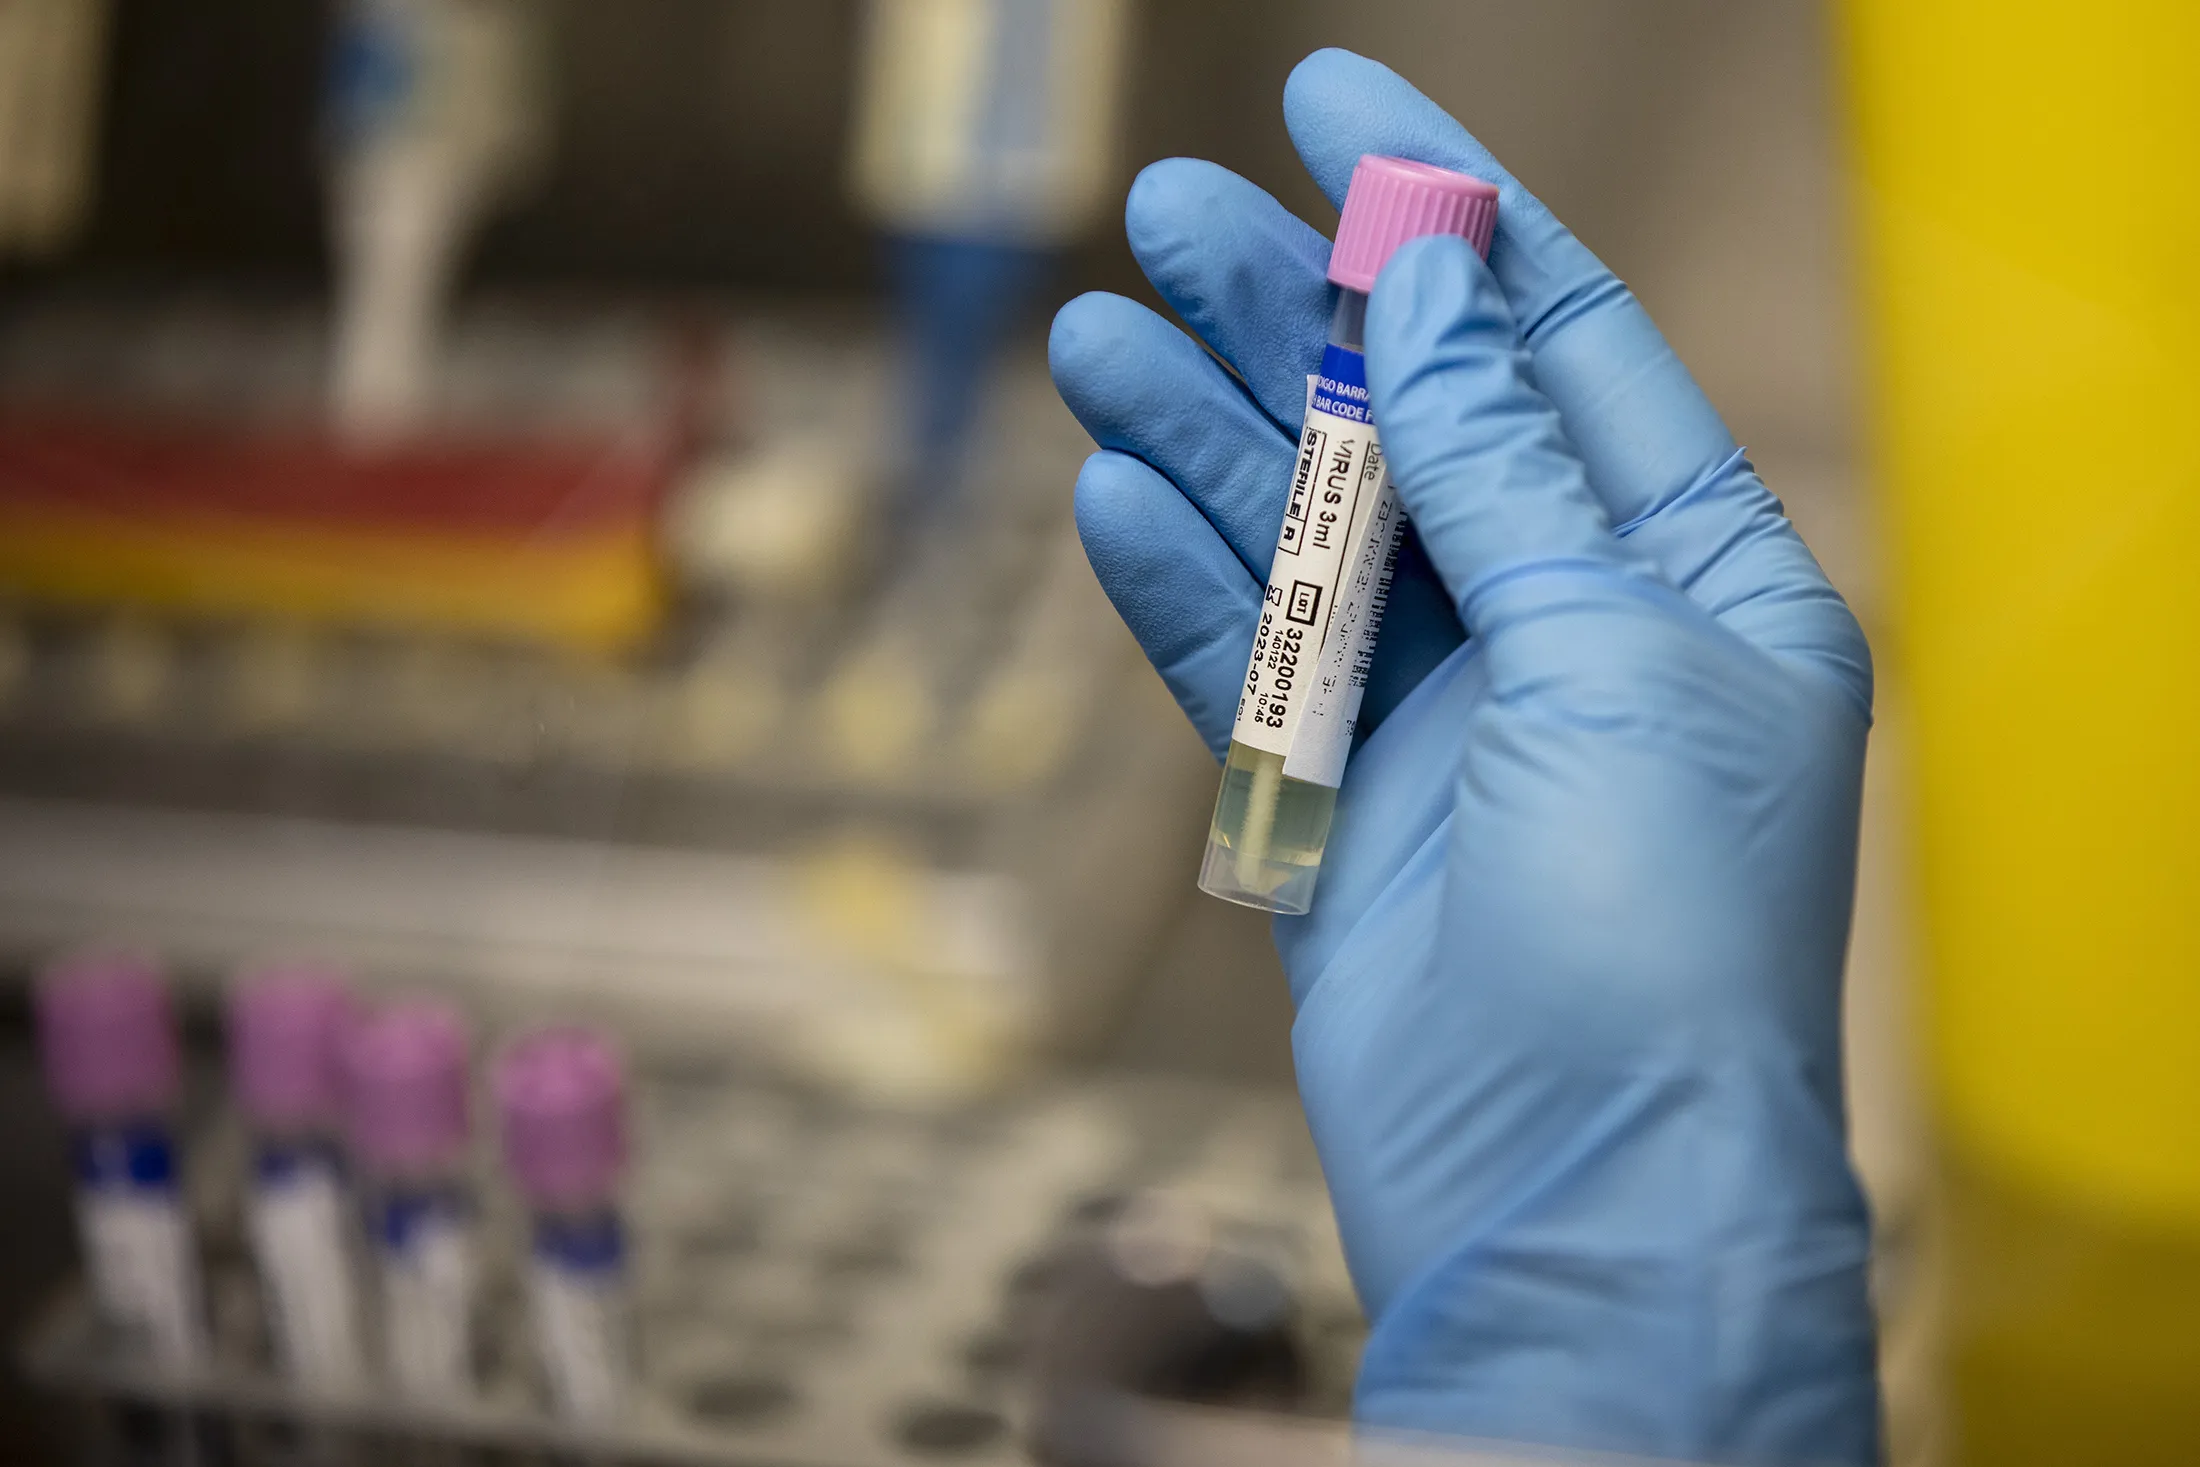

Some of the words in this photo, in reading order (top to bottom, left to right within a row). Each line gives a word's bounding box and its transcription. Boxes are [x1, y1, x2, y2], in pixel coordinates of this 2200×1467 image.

[1316, 396, 1332, 412] BAR
[1331, 401, 1365, 419] CODE
[1324, 439, 1354, 505] VIRUS
[1363, 443, 1384, 481] Date
[1312, 510, 1337, 550] 3ml
[1296, 592, 1310, 615] LOT
[1246, 611, 1272, 695] 2023-07
[1266, 630, 1284, 670] 140122
[1265, 627, 1303, 729] 32200193
